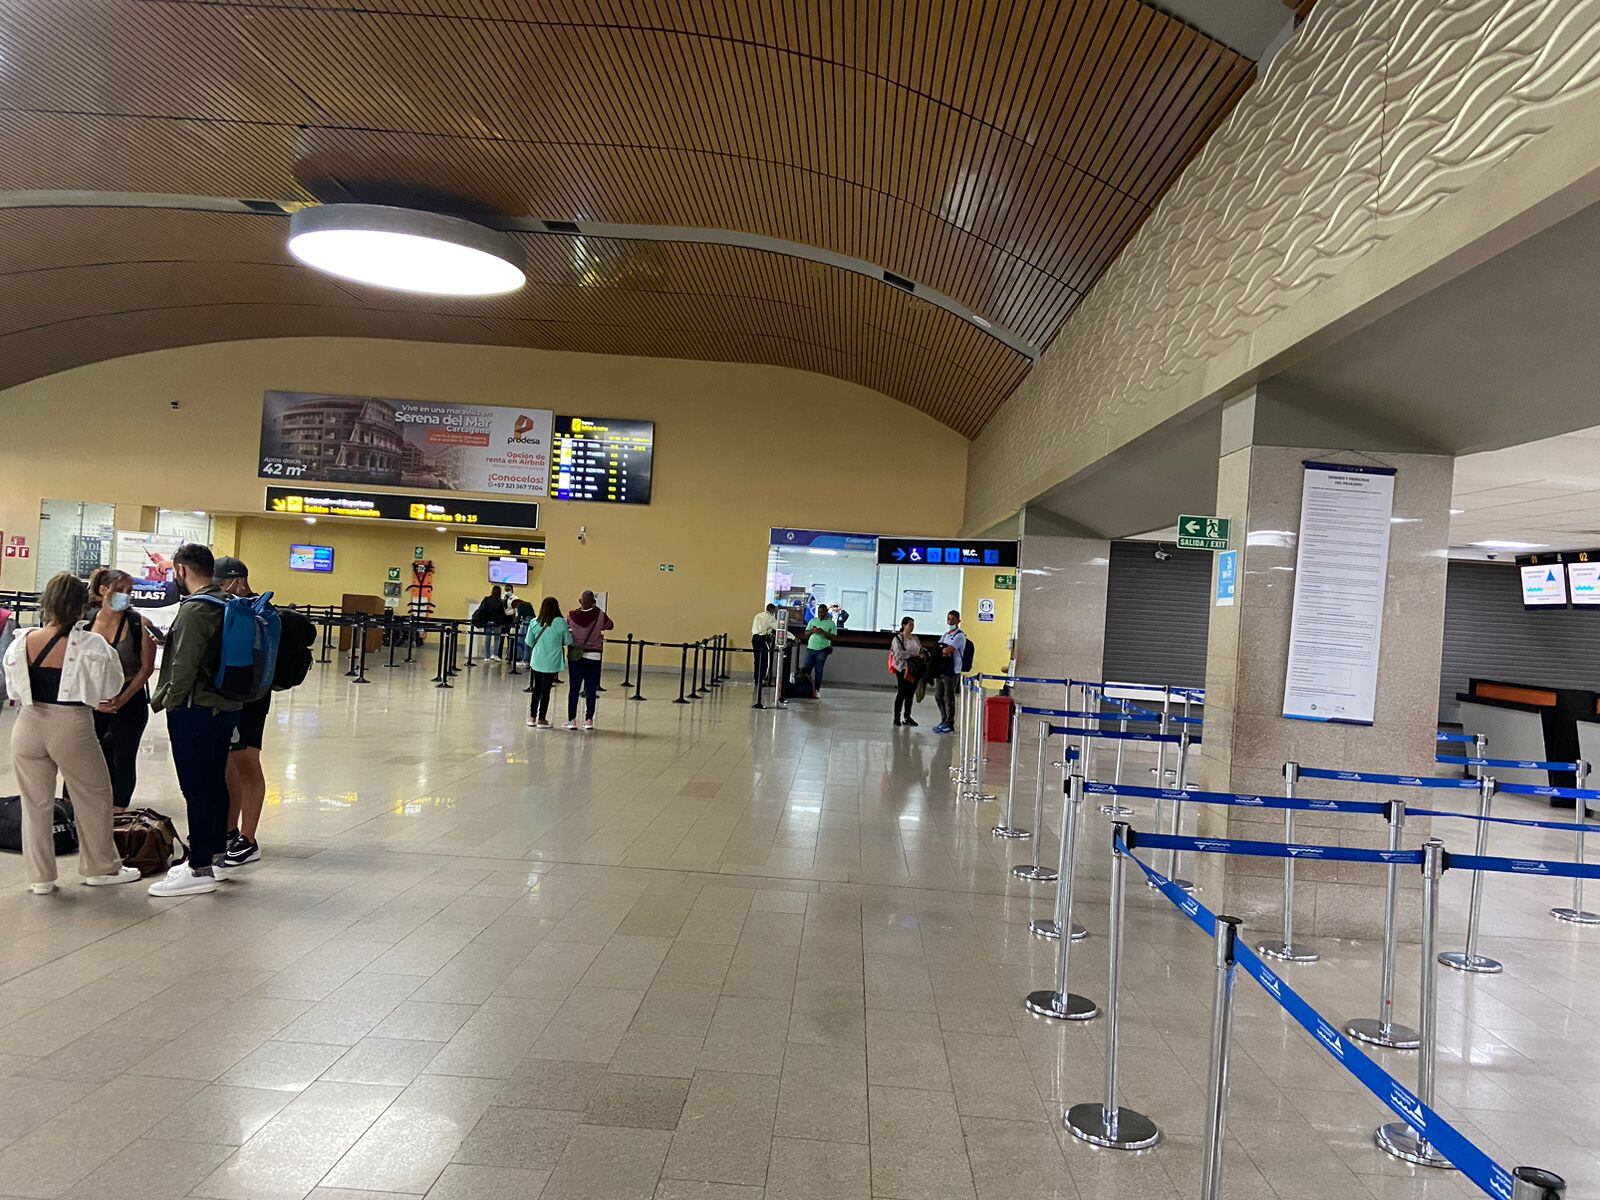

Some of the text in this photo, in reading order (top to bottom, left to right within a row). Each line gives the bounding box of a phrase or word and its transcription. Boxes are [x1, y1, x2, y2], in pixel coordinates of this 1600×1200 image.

[402, 404, 419, 412] Vive
[395, 411, 492, 428] Serena del Mar
[446, 425, 490, 435] Cartagena
[507, 436, 541, 445] prodesa
[506, 451, 534, 459] Opción
[519, 458, 545, 466] Airbnb
[262, 463, 307, 476] 42 m²
[303, 504, 329, 514] Salidas
[1179, 538, 1205, 548] SALIDA
[1210, 540, 1226, 549] EXIT
[962, 548, 978, 557] W.C.
[1579, 551, 1589, 562] 02
